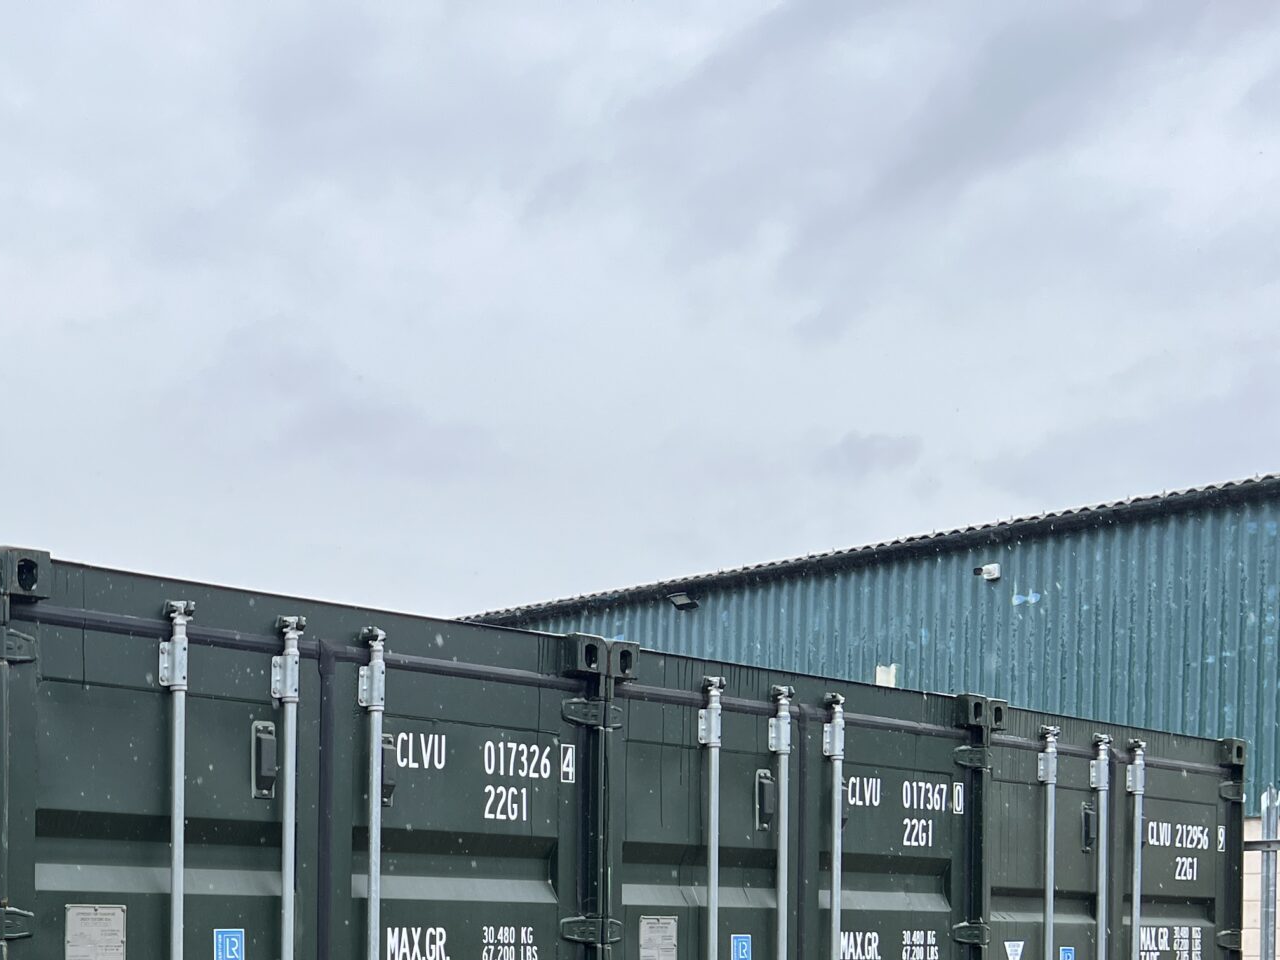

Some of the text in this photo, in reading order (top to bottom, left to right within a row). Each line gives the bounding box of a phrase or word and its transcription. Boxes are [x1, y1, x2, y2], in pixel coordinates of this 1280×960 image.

[396, 732, 574, 781] CLVU 017326 4
[484, 784, 527, 821] 22G1
[848, 776, 962, 812] CLVU 017367 0
[902, 818, 933, 847] 22G1
[1148, 821, 1171, 847] CLVU
[1175, 824, 1209, 850] 212956
[1175, 857, 1197, 880] 22G1
[226, 937, 239, 958] LR
[521, 926, 533, 944] KG
[927, 930, 936, 945] KG
[926, 946, 939, 960] LBS
